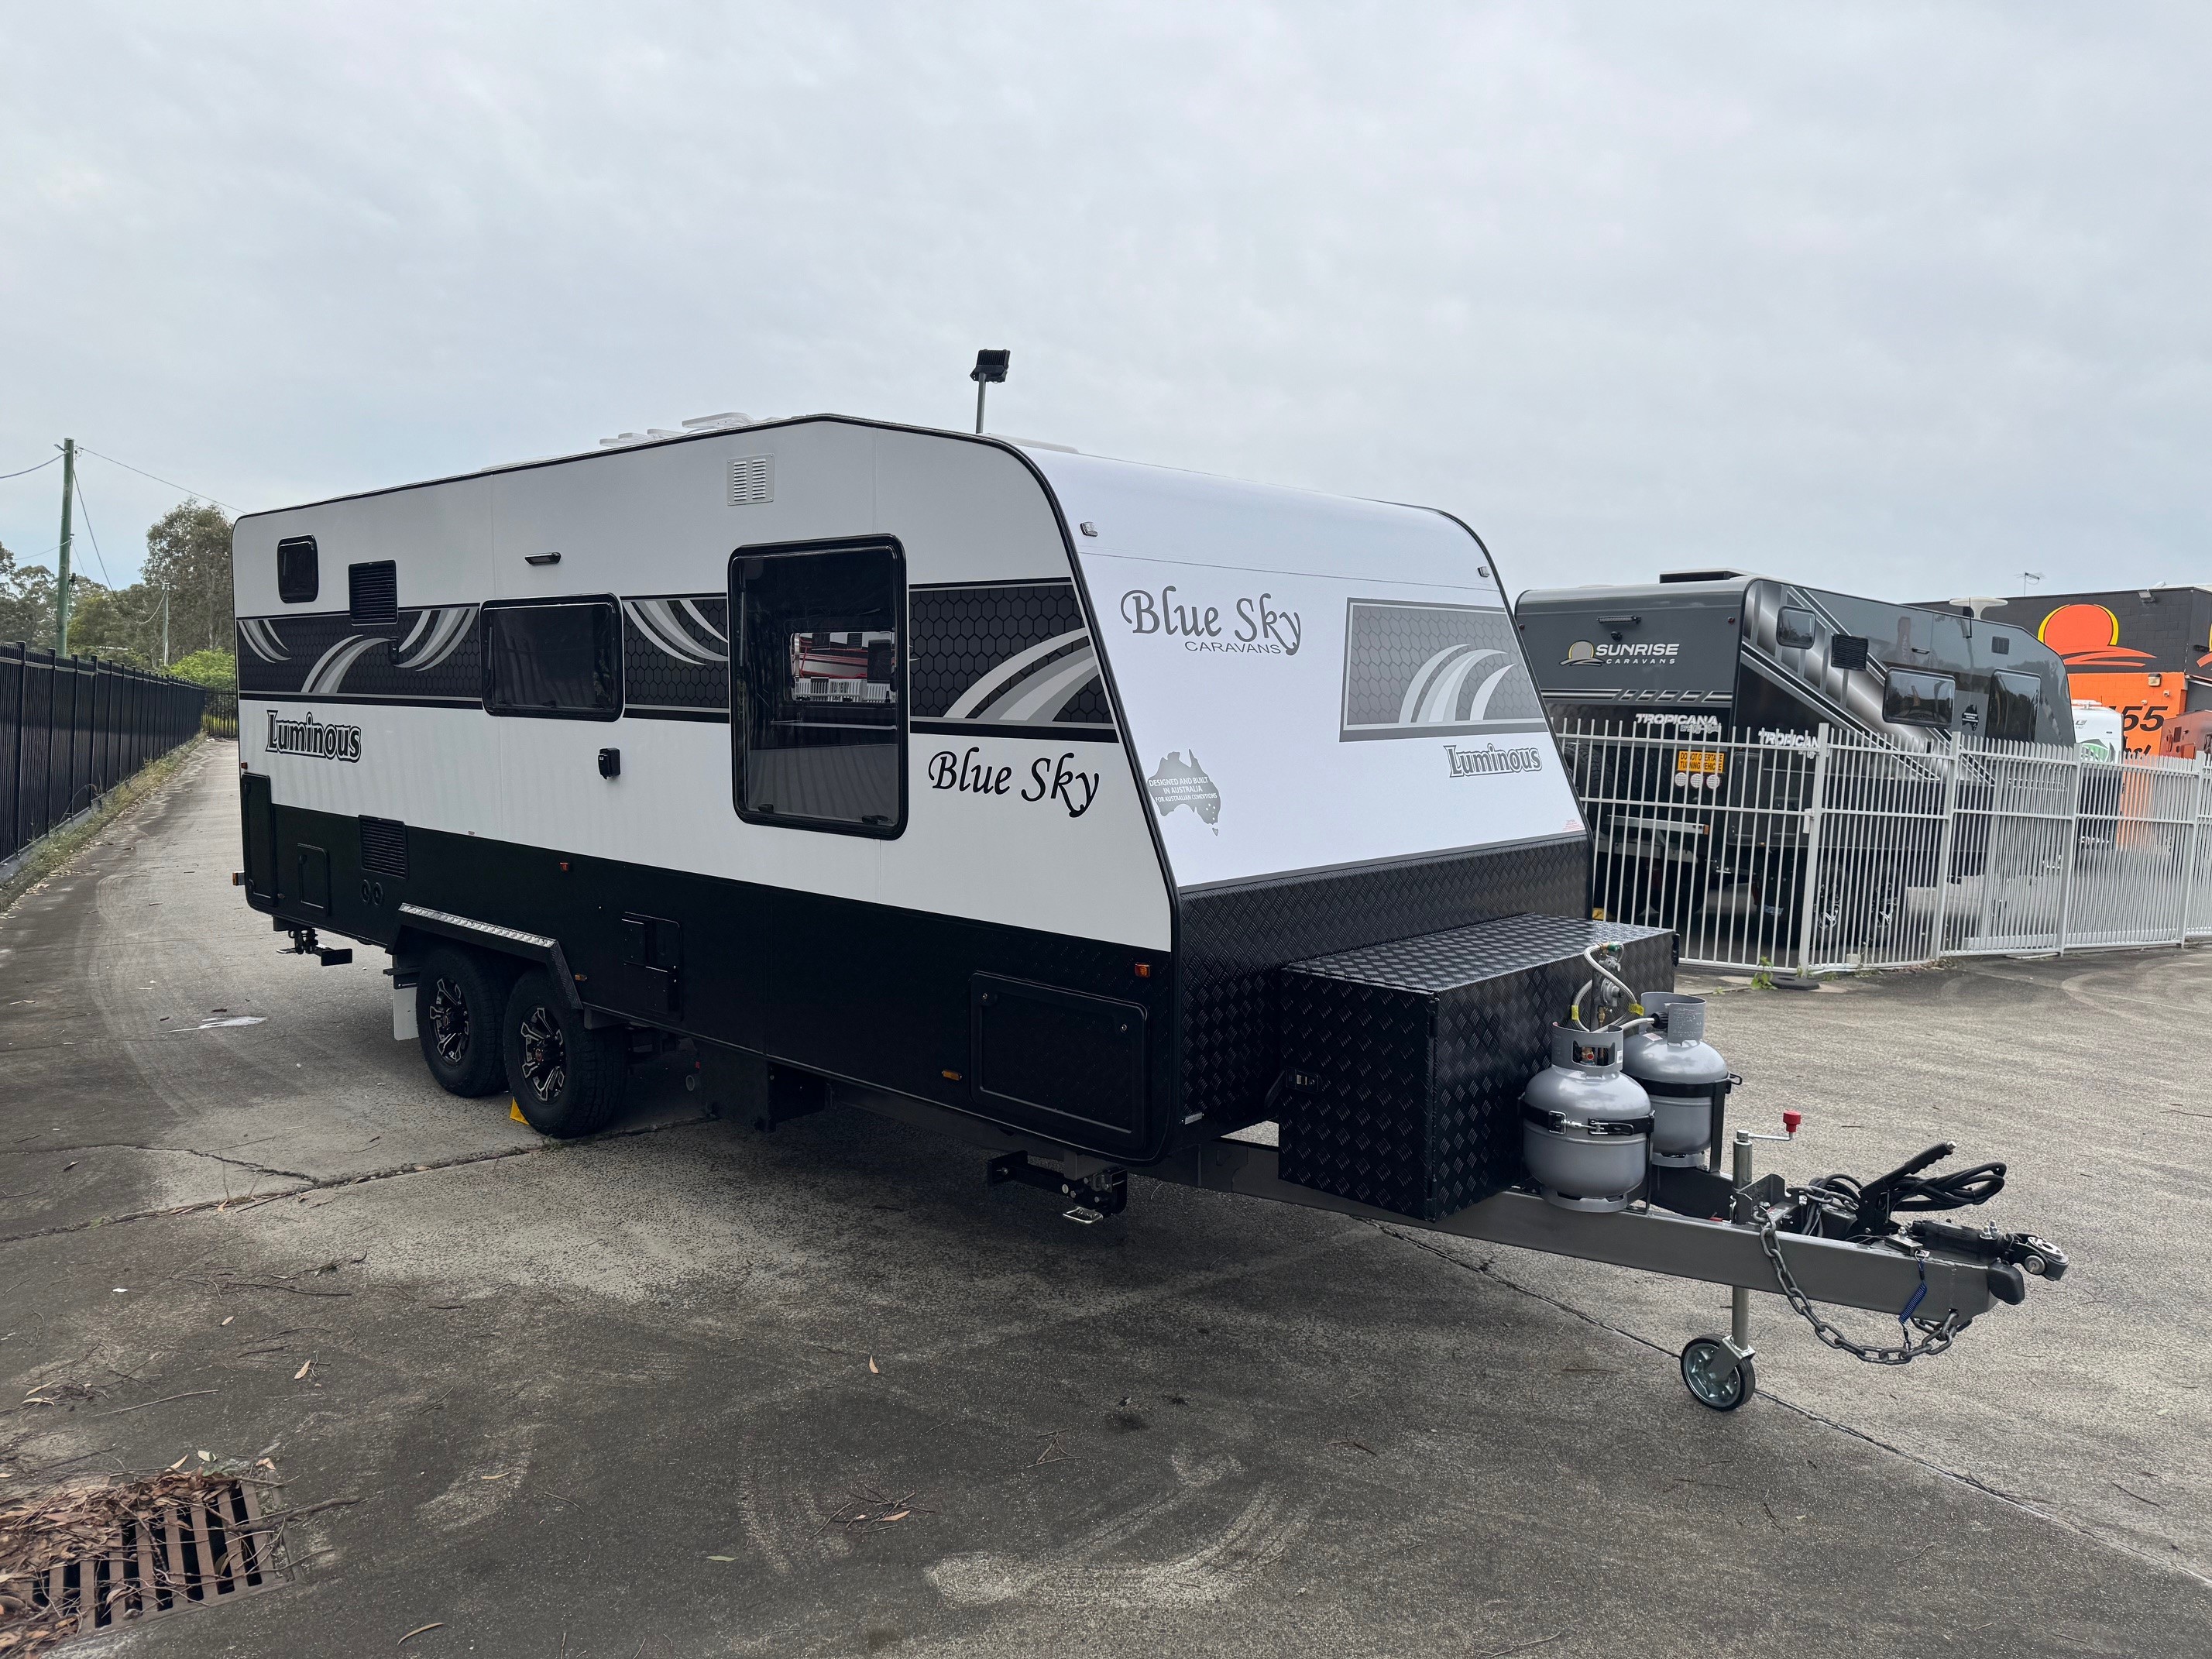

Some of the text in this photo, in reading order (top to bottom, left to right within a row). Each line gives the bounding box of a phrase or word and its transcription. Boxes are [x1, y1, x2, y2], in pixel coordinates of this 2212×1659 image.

[1120, 586, 1301, 656] Blue Sky
[1184, 641, 1281, 654] CARAVANS
[1595, 643, 1680, 656] SUNRISE
[1635, 713, 1719, 726] TROPICANA
[2109, 706, 2168, 732] 55
[265, 709, 362, 763] Luminous
[1757, 730, 1819, 747] TROPICAN
[1443, 743, 1543, 778] Luminous
[928, 747, 1100, 818] Blue Sky
[1148, 778, 1179, 787] DESIGNED
[1171, 785, 1203, 794] AUSTRALIA
